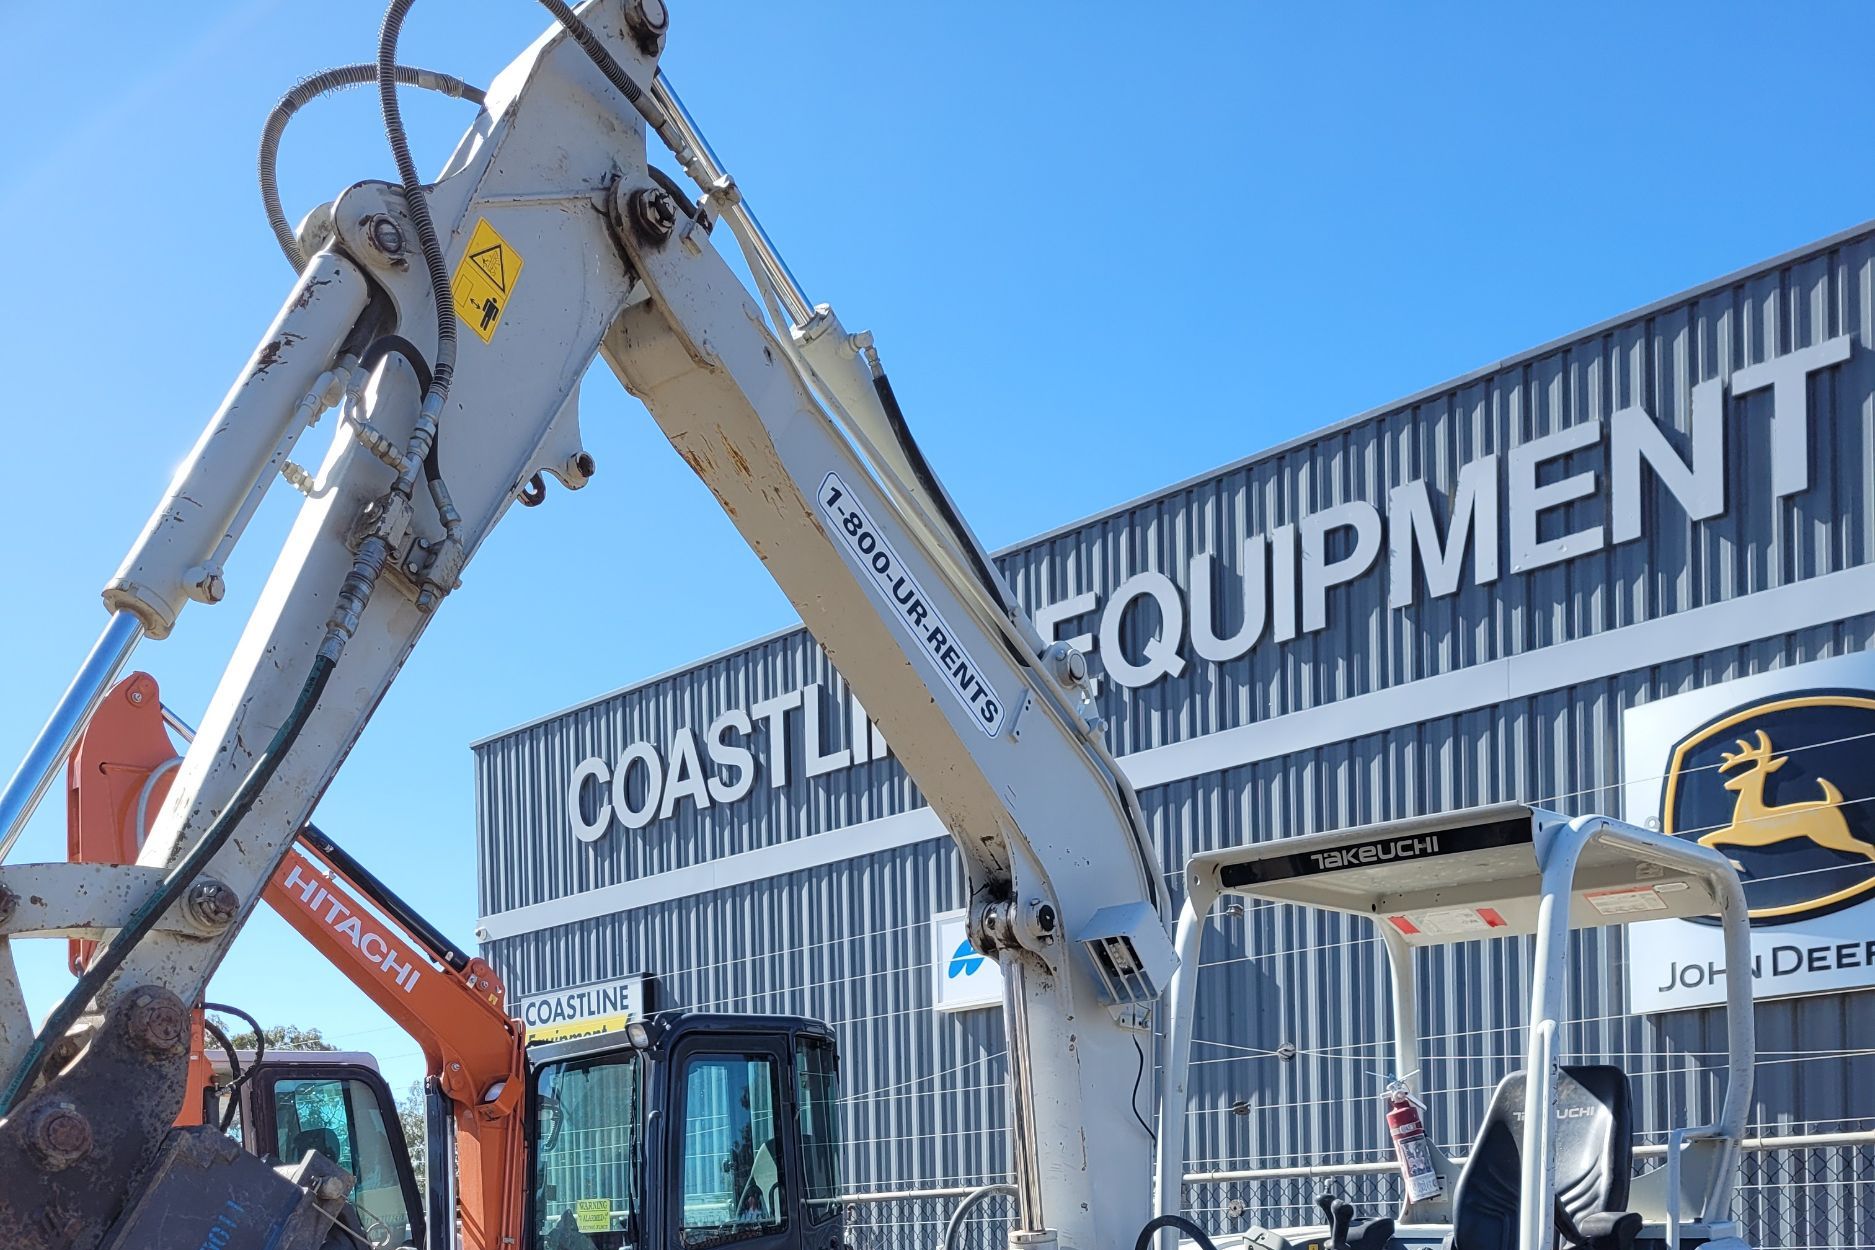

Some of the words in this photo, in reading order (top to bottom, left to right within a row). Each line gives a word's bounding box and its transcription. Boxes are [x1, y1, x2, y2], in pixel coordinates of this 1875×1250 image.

[826, 487, 998, 723] 1-800-UR-RENTS
[569, 682, 888, 842] COASTLI
[284, 865, 421, 993] HITACHI
[525, 985, 629, 1026] COASTLINE
